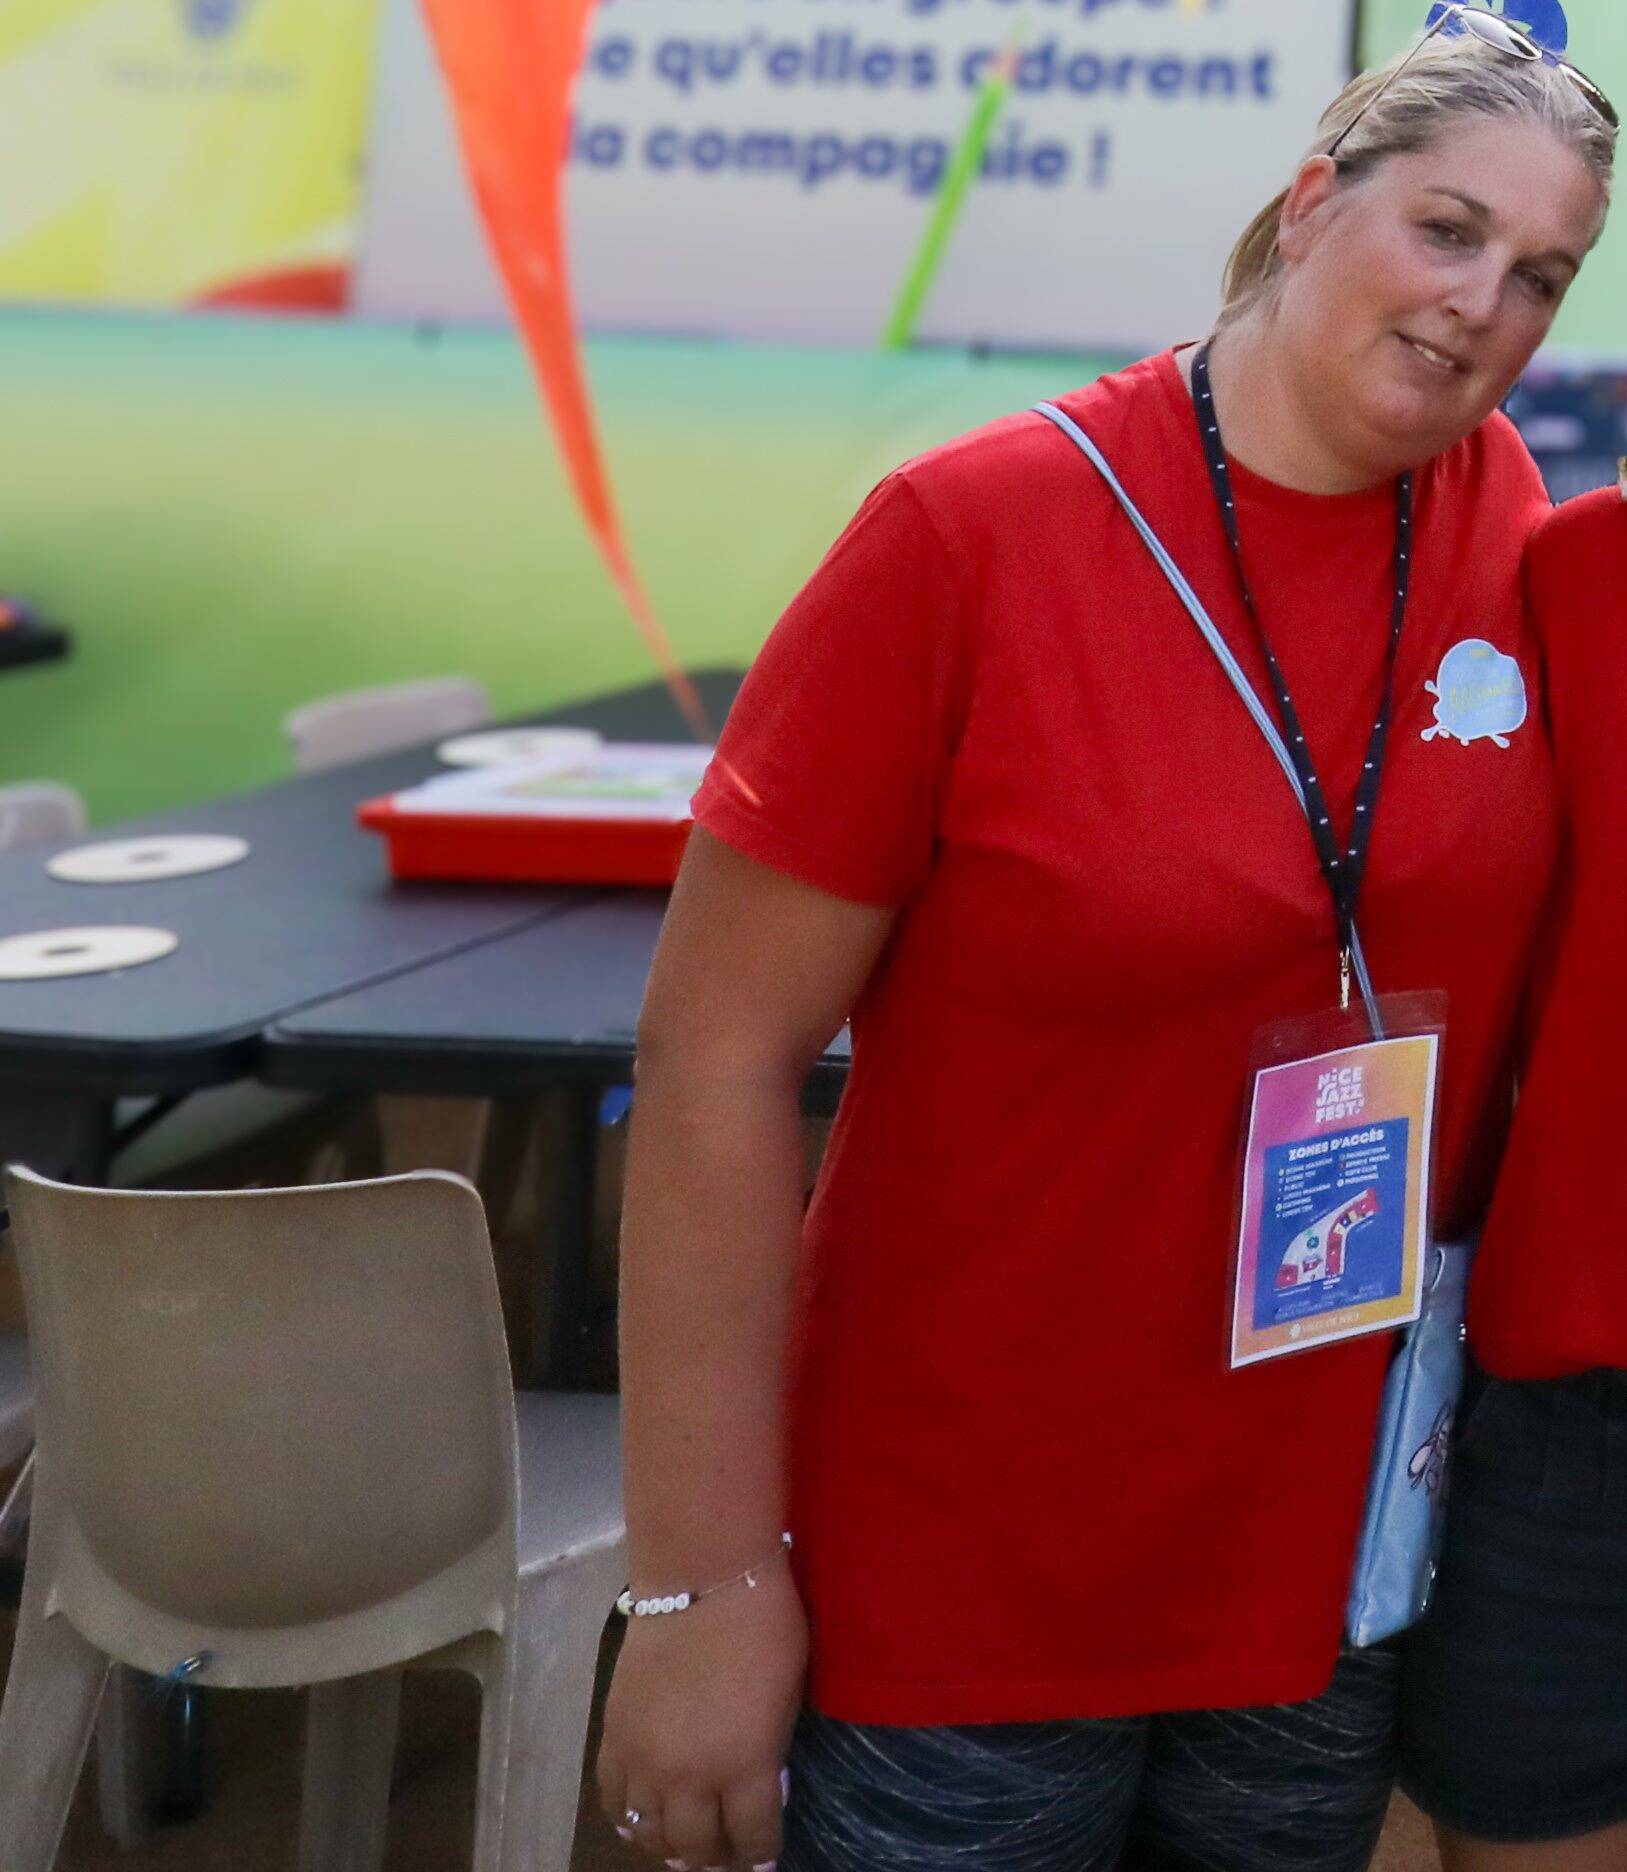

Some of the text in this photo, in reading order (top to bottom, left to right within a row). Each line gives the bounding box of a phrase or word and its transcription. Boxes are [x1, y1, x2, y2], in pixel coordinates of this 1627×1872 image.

[655, 30, 940, 96] qu'elles
[643, 122, 1070, 196] compagie
[1288, 1141, 1330, 1162] ZONES
